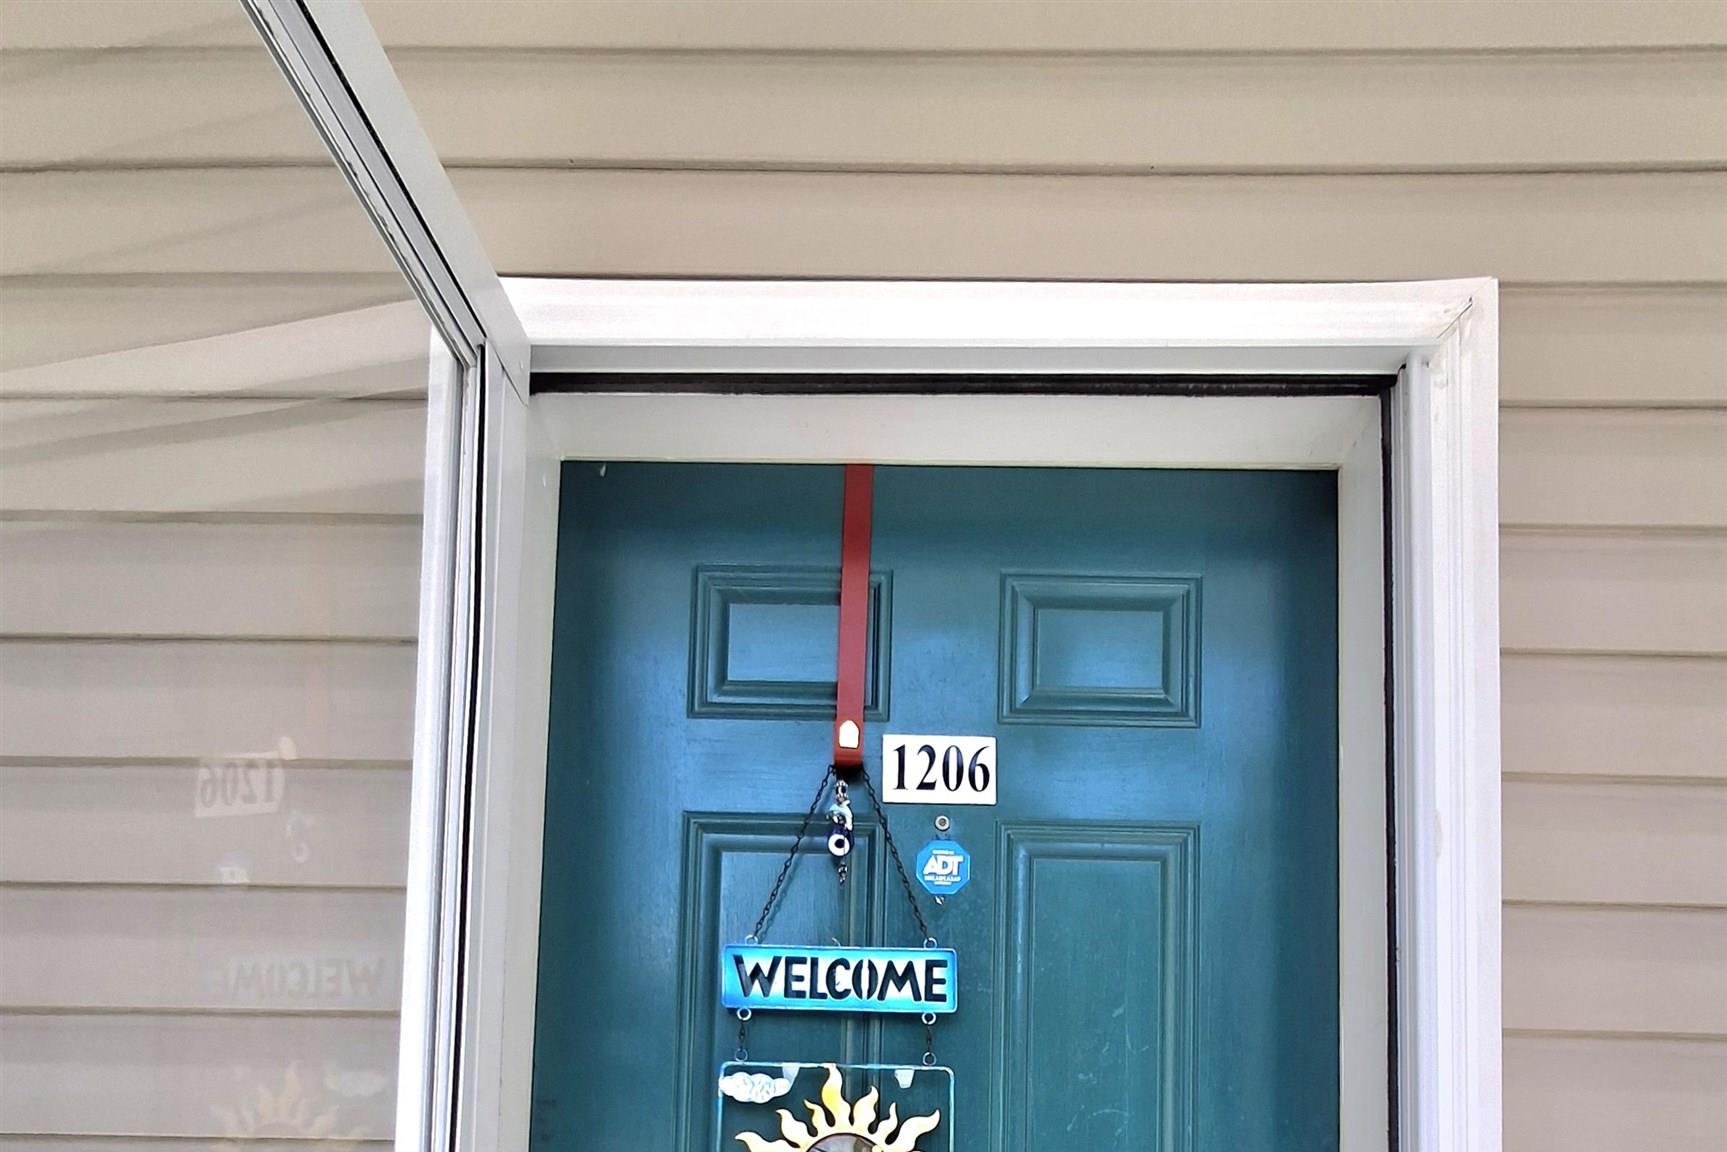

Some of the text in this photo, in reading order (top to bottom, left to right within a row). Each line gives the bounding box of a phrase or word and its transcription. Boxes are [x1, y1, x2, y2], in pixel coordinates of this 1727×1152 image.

[892, 743, 991, 792] 1206
[923, 855, 964, 875] ADT
[732, 954, 949, 1003] WELCOME
